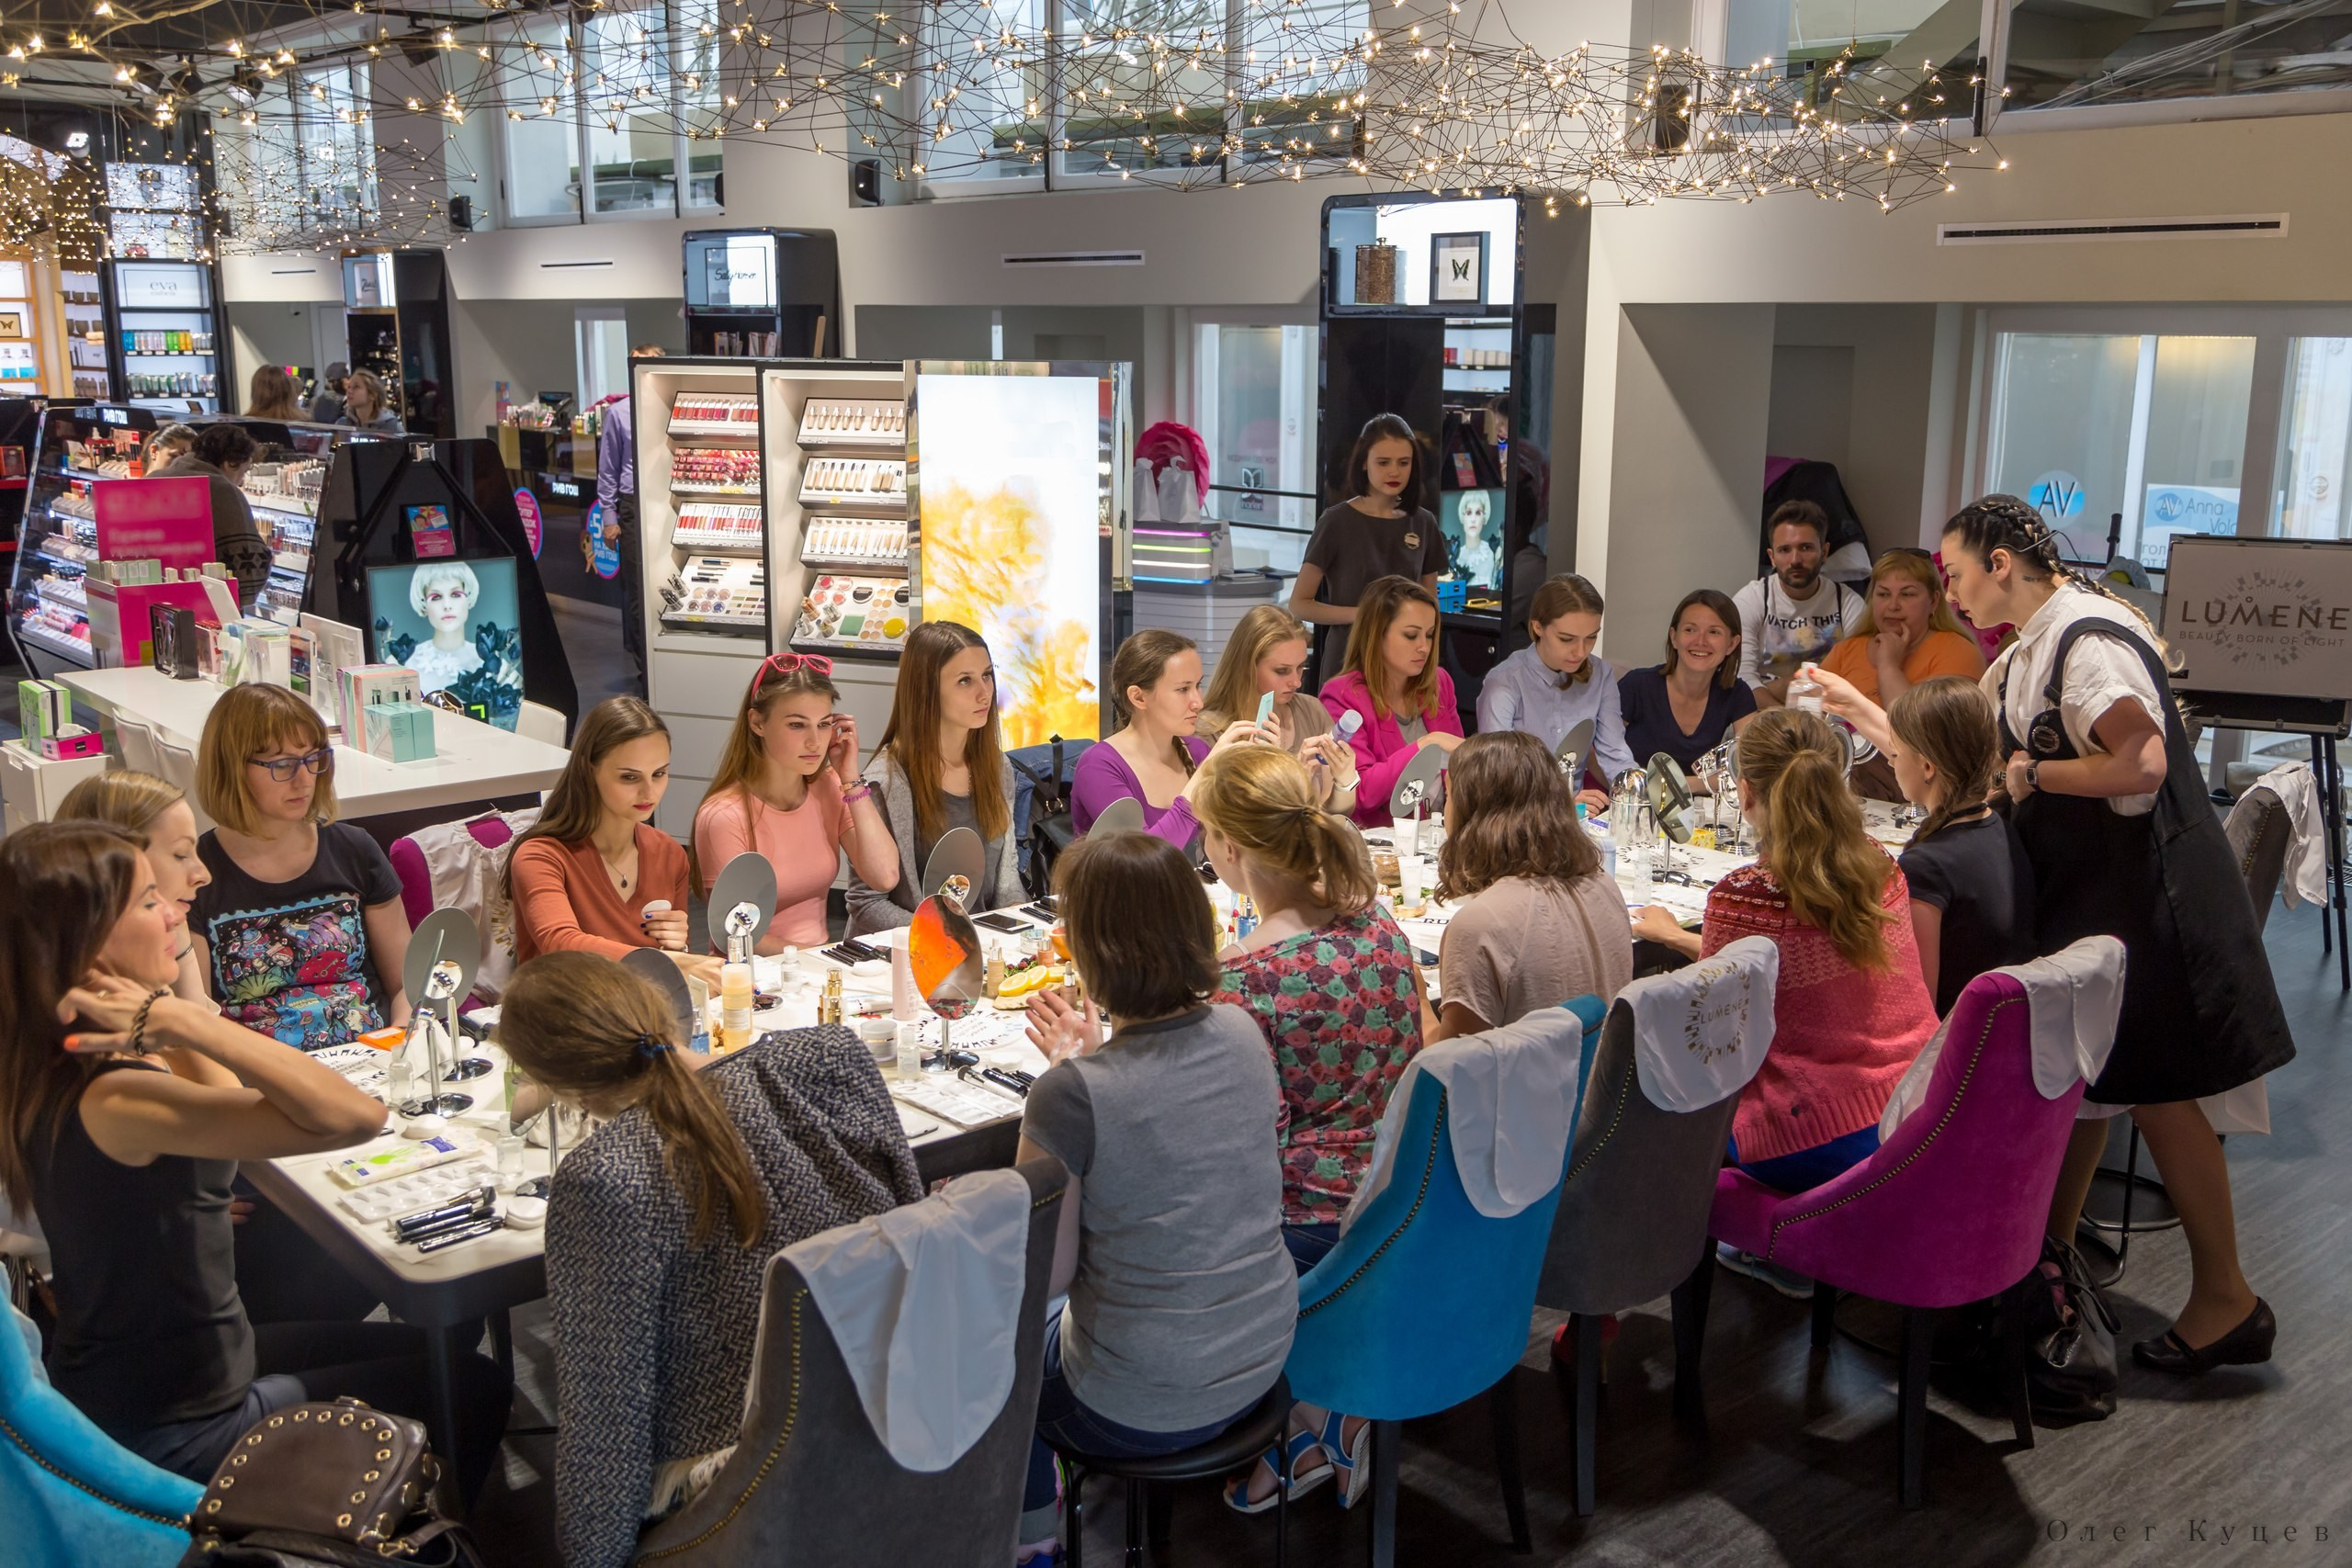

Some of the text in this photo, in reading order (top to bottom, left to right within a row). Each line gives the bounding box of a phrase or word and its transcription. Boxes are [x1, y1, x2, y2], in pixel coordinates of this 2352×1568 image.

[150, 281, 177, 290] eva
[551, 481, 580, 497] РИВ ГОШ
[2038, 479, 2077, 518] AV
[2185, 497, 2224, 516] Anna
[1812, 613, 1841, 626] THIS
[2181, 596, 2351, 630] LUMENE
[2179, 630, 2346, 648] BEAUTY BORN OF LIGHT
[1701, 998, 1744, 1024] LUMENE
